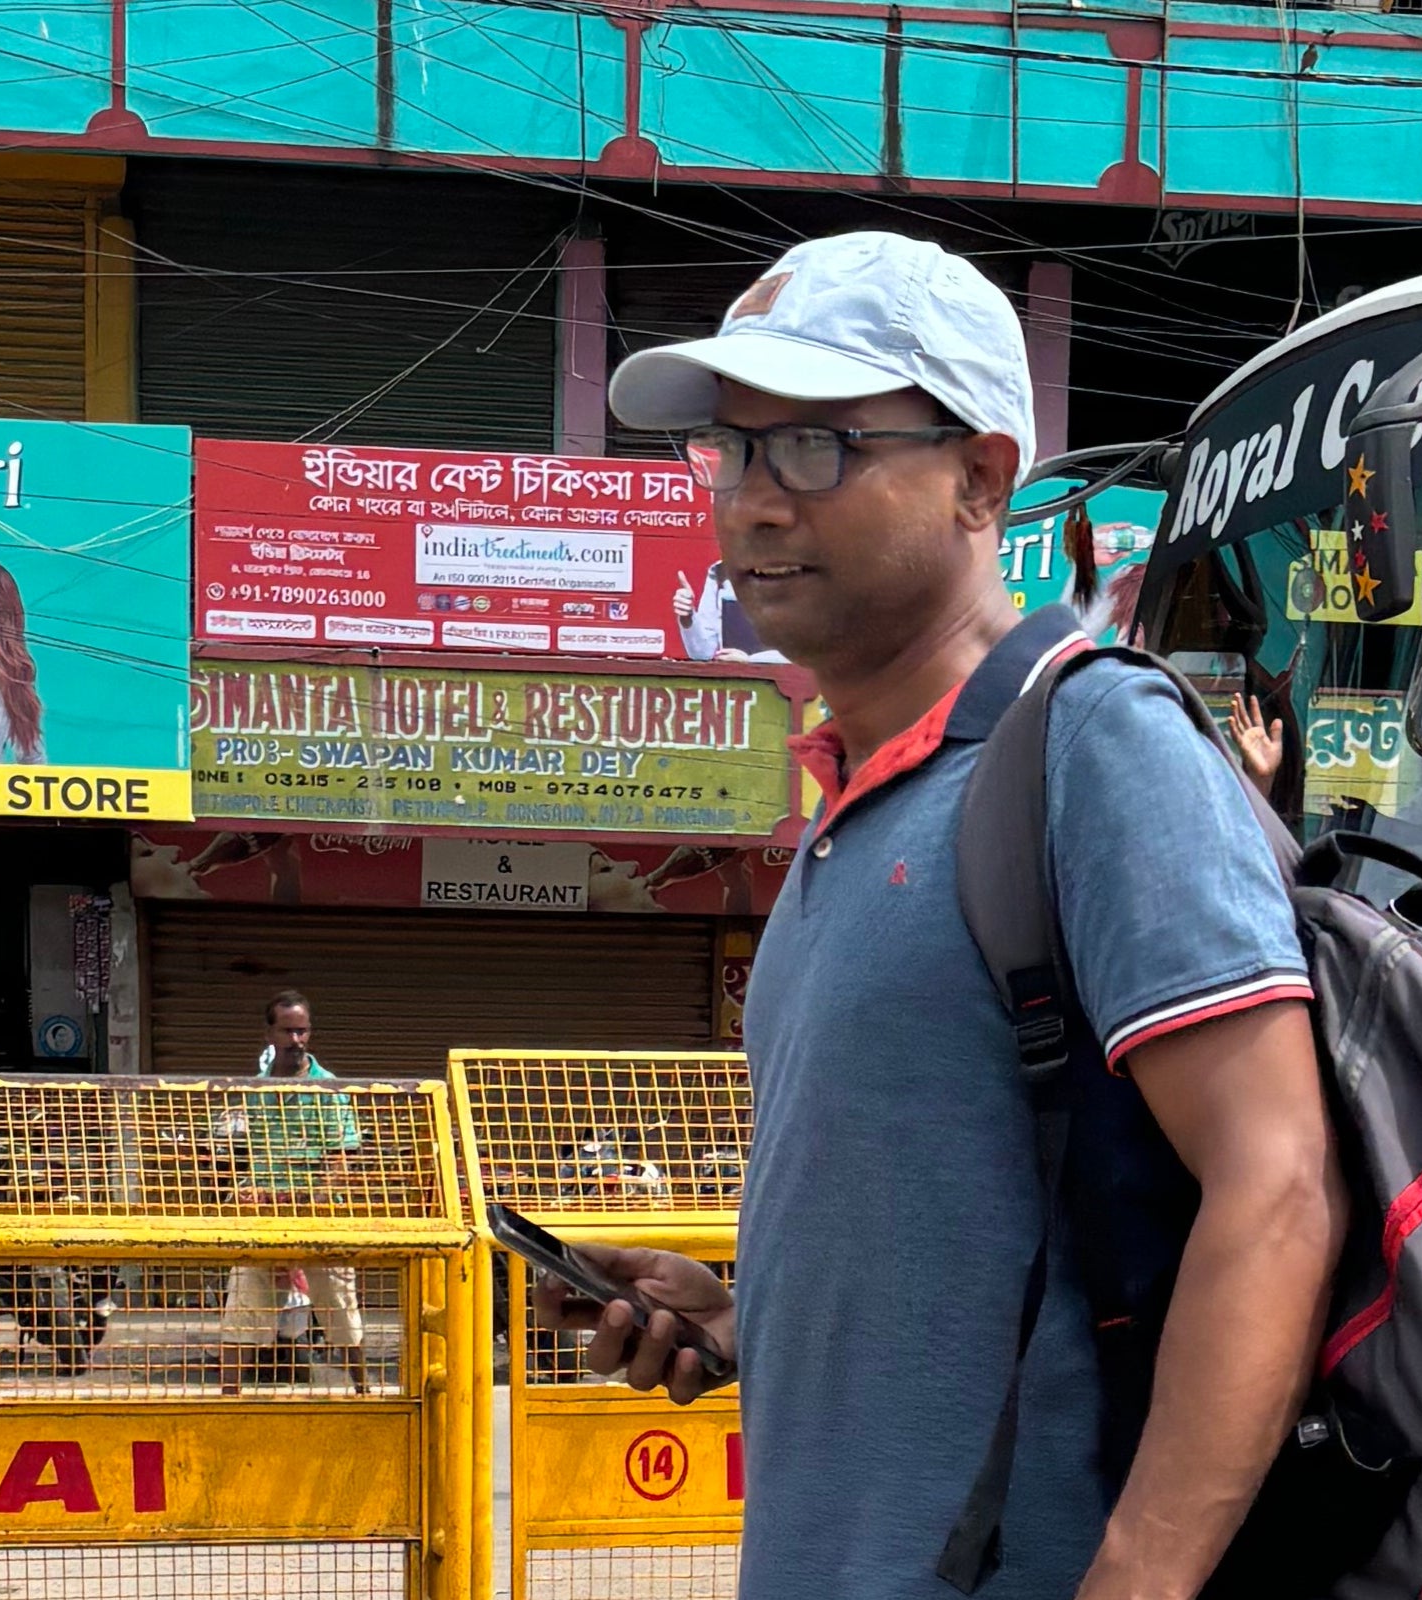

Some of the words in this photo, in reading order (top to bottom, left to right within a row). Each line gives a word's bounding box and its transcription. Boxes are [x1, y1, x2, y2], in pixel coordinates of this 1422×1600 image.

[302, 449, 421, 493] ইন্ডিয়ার
[430, 459, 503, 494] বেস্ট
[511, 456, 634, 504] চিকিৎসা
[643, 471, 695, 503] চান
[1168, 383, 1316, 546] Royal
[371, 677, 493, 743] HOTEL
[523, 682, 757, 750] RESTURENT
[298, 741, 435, 772] SWAPAN
[451, 744, 565, 776] KUMAR
[581, 750, 644, 779] DEY
[7, 773, 150, 813] STORE
[265, 773, 329, 788] 03215
[479, 780, 517, 794] MOB
[497, 855, 513, 874] &
[427, 881, 583, 904] RESTAURANT
[637, 1445, 675, 1483] 14
